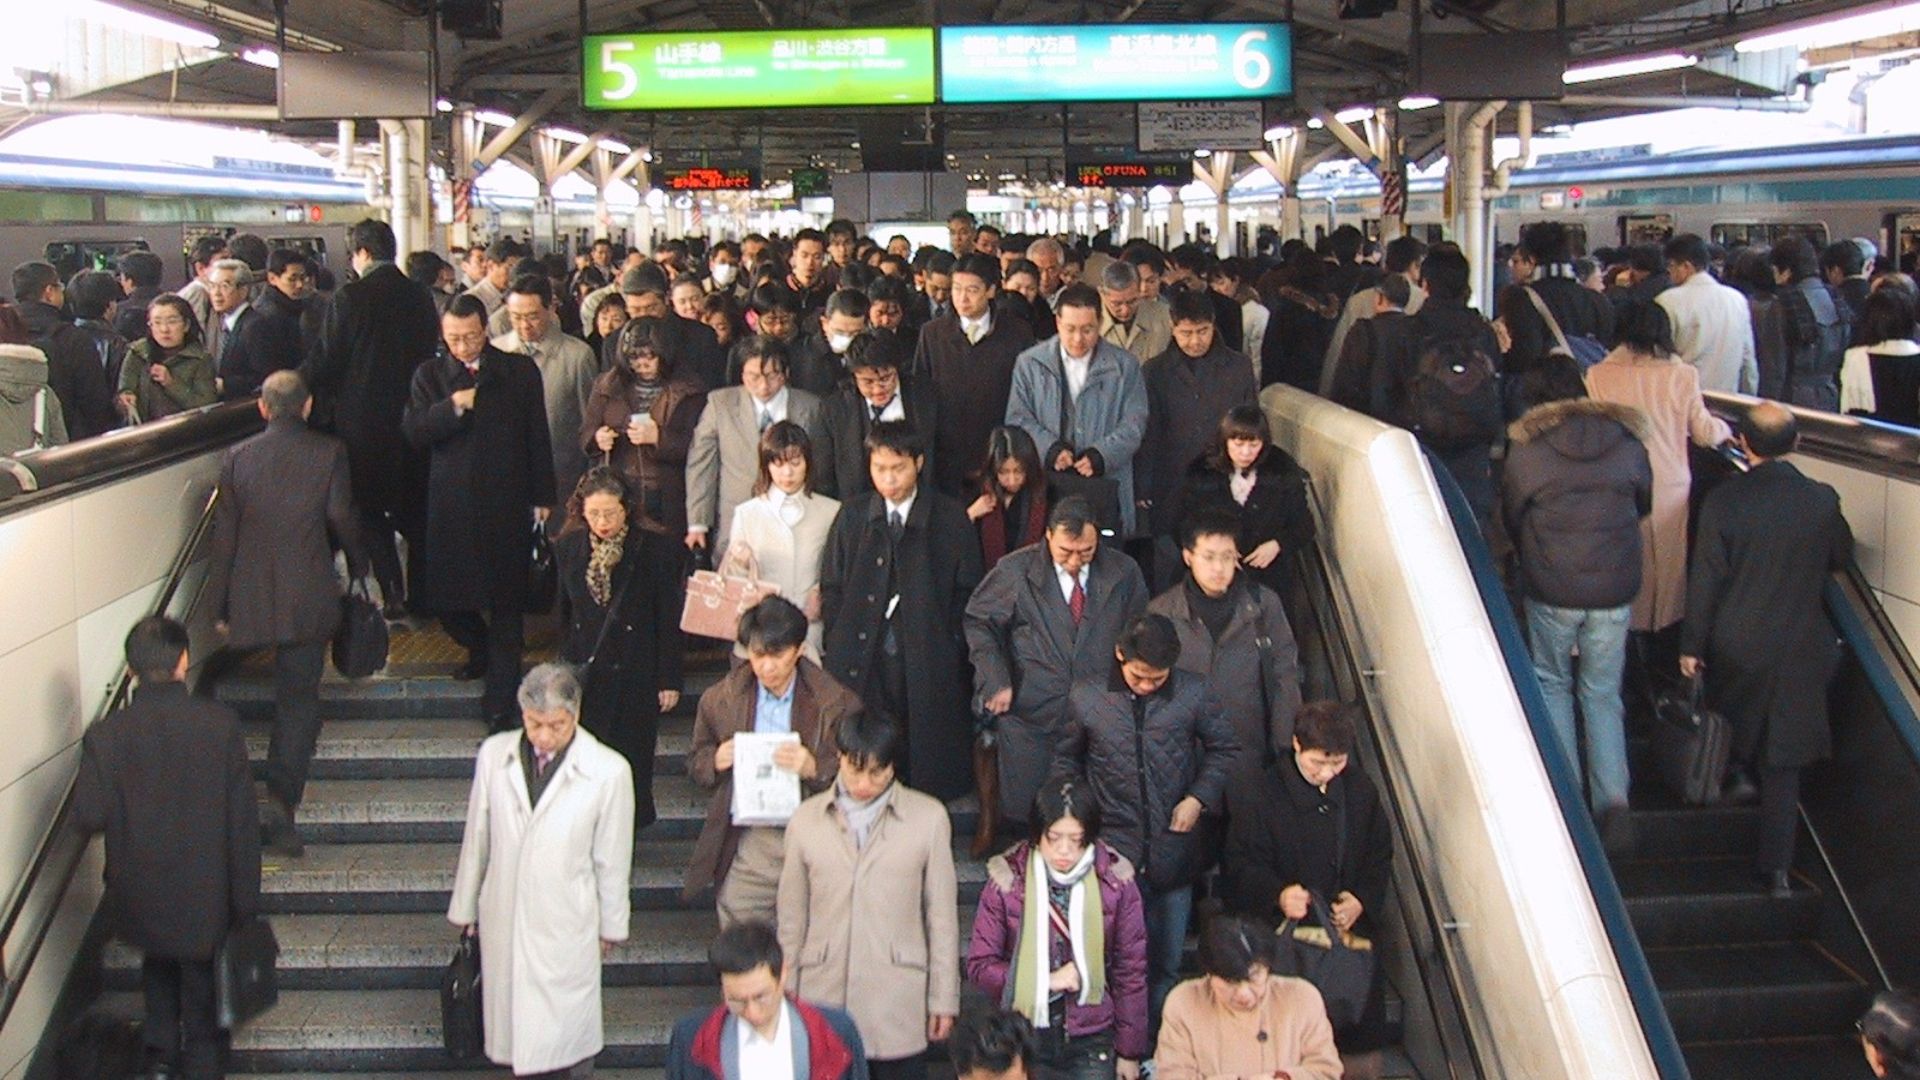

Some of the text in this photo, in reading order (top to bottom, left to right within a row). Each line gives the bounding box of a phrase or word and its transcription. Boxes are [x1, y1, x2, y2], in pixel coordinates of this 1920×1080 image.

[602, 42, 637, 99] 5
[1233, 31, 1271, 89] 6
[1103, 165, 1147, 177] OFUNA
